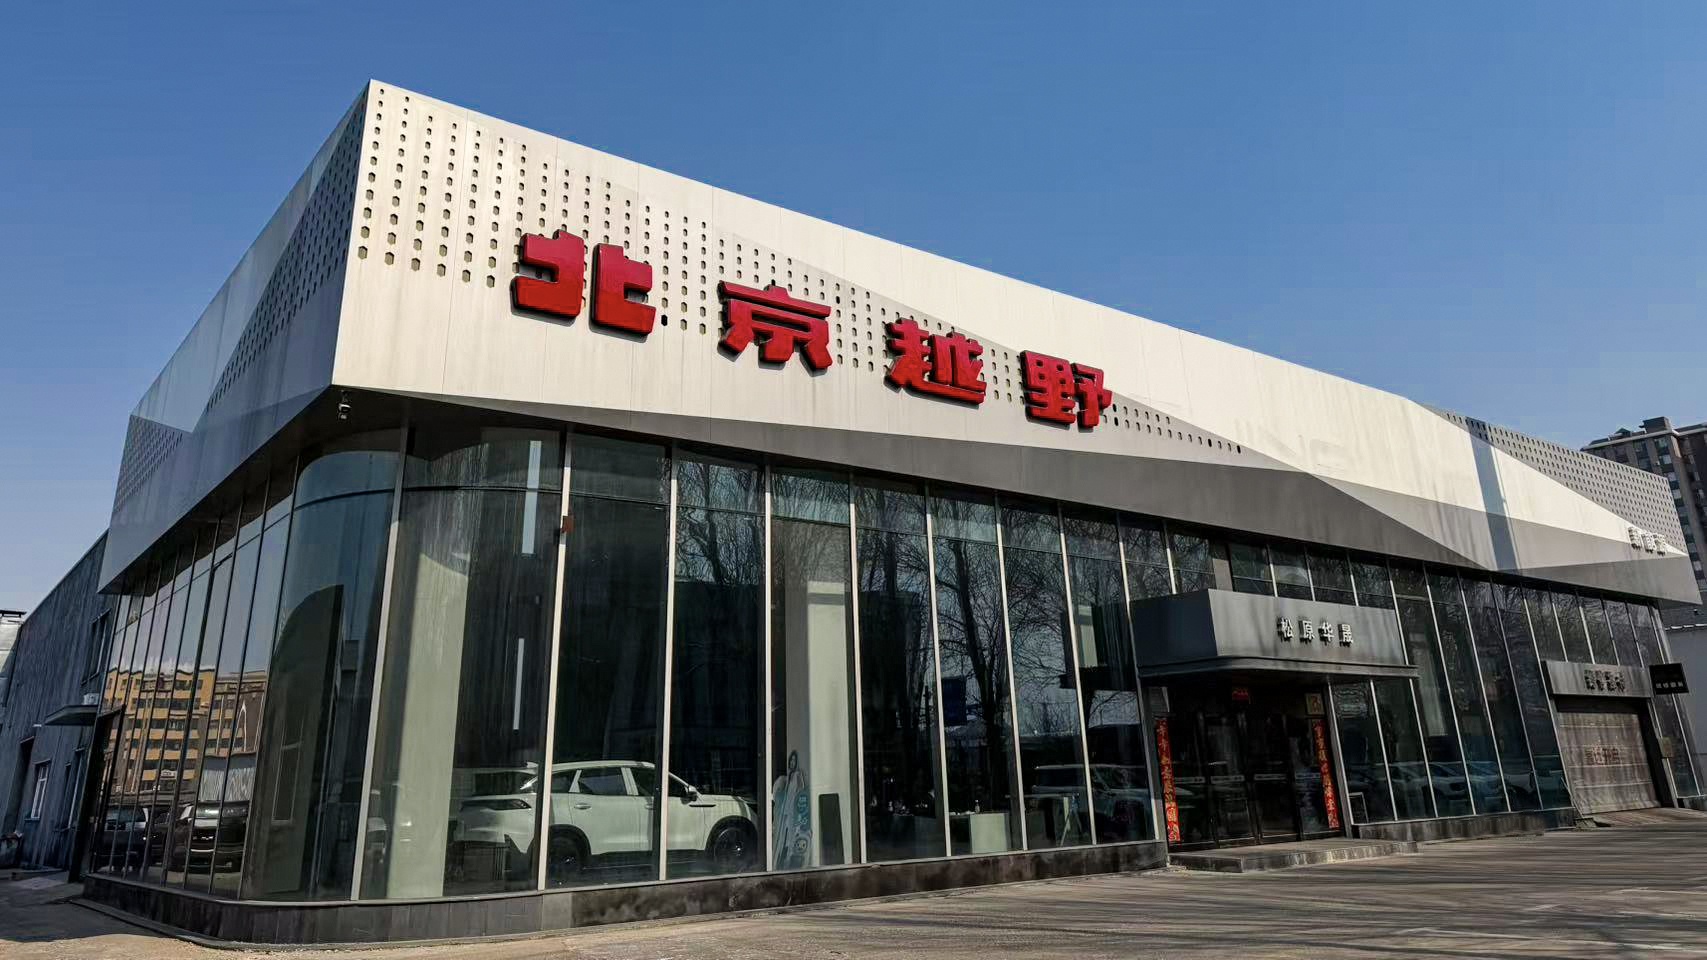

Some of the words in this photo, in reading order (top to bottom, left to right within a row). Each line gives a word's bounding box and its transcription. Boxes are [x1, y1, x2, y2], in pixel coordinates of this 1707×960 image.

[510, 229, 1113, 430] 北京越野
[1279, 617, 1353, 645] 松原华晟
